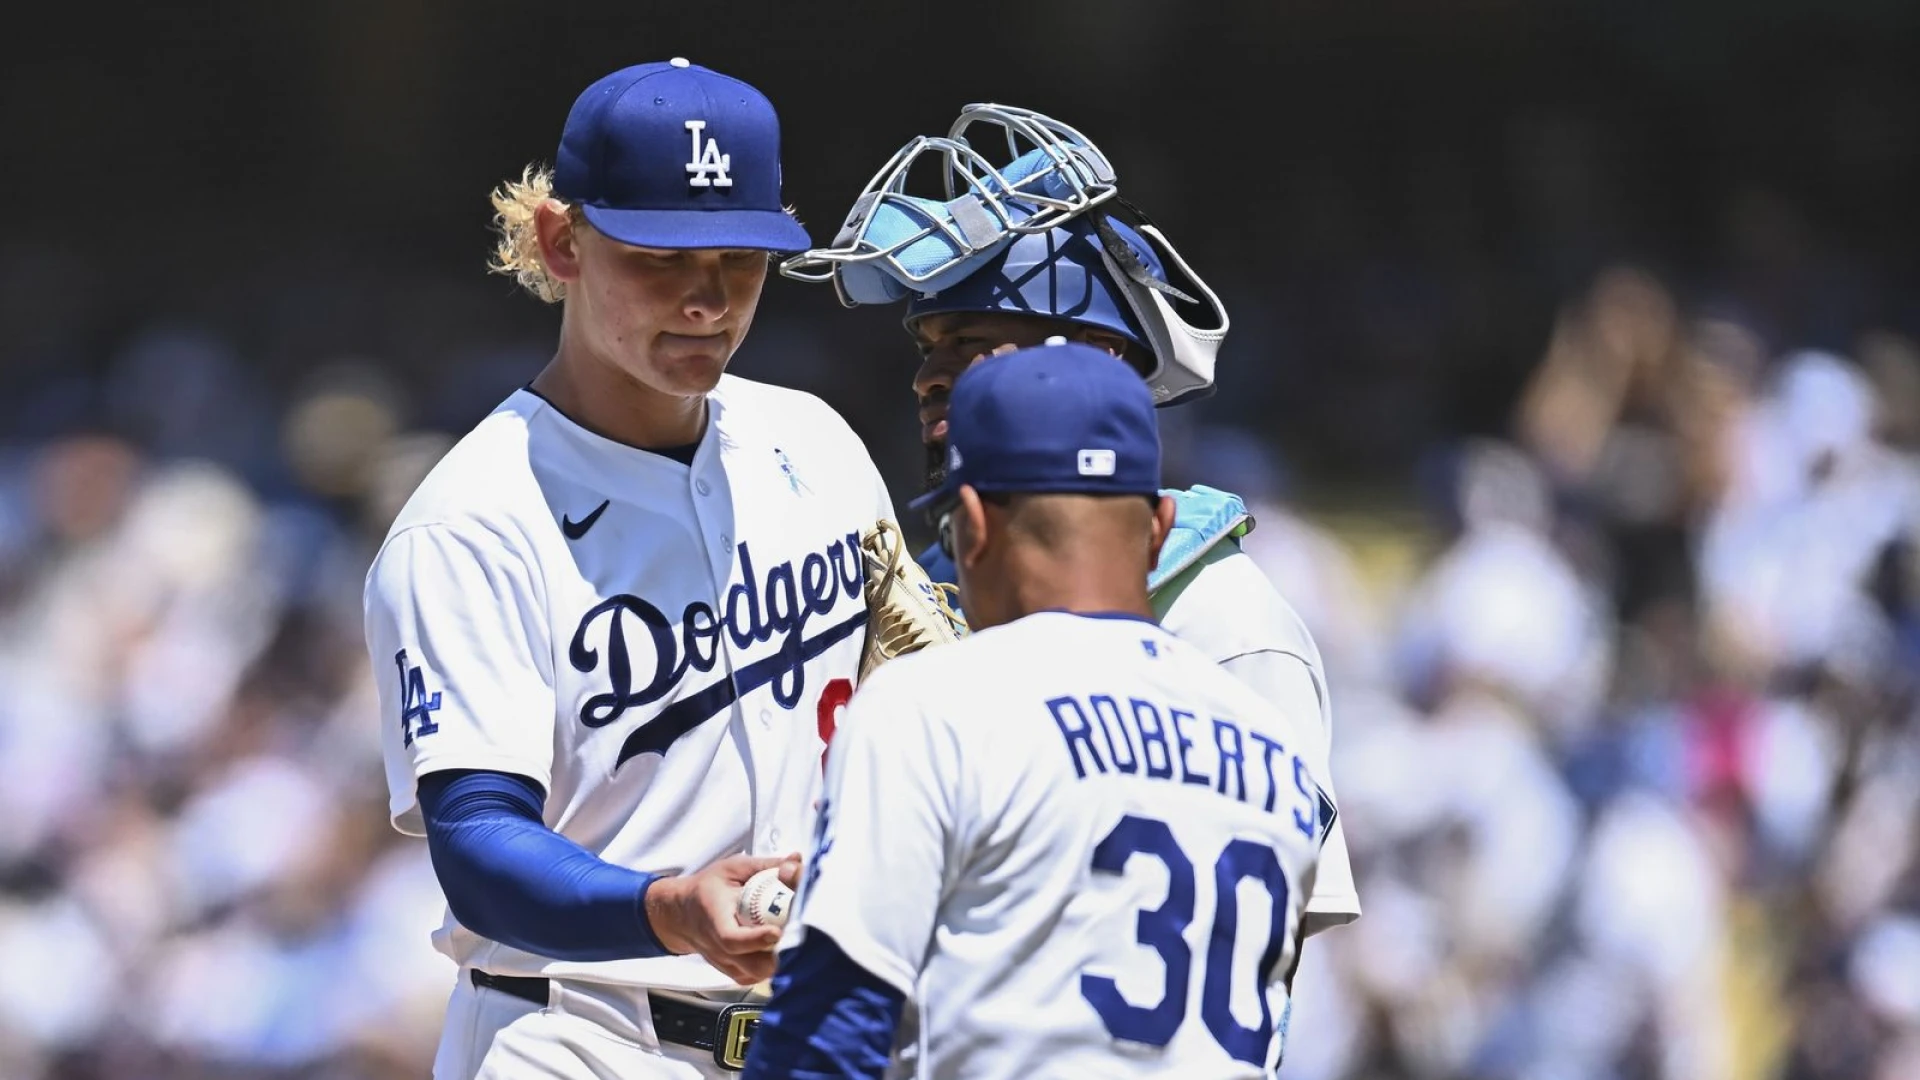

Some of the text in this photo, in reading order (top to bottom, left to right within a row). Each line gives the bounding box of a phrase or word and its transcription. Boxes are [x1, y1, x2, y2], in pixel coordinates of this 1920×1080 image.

[684, 120, 733, 187] LA
[395, 648, 442, 750] LA
[1045, 695, 1314, 839] ROBERTS
[1081, 814, 1288, 1068] 30
